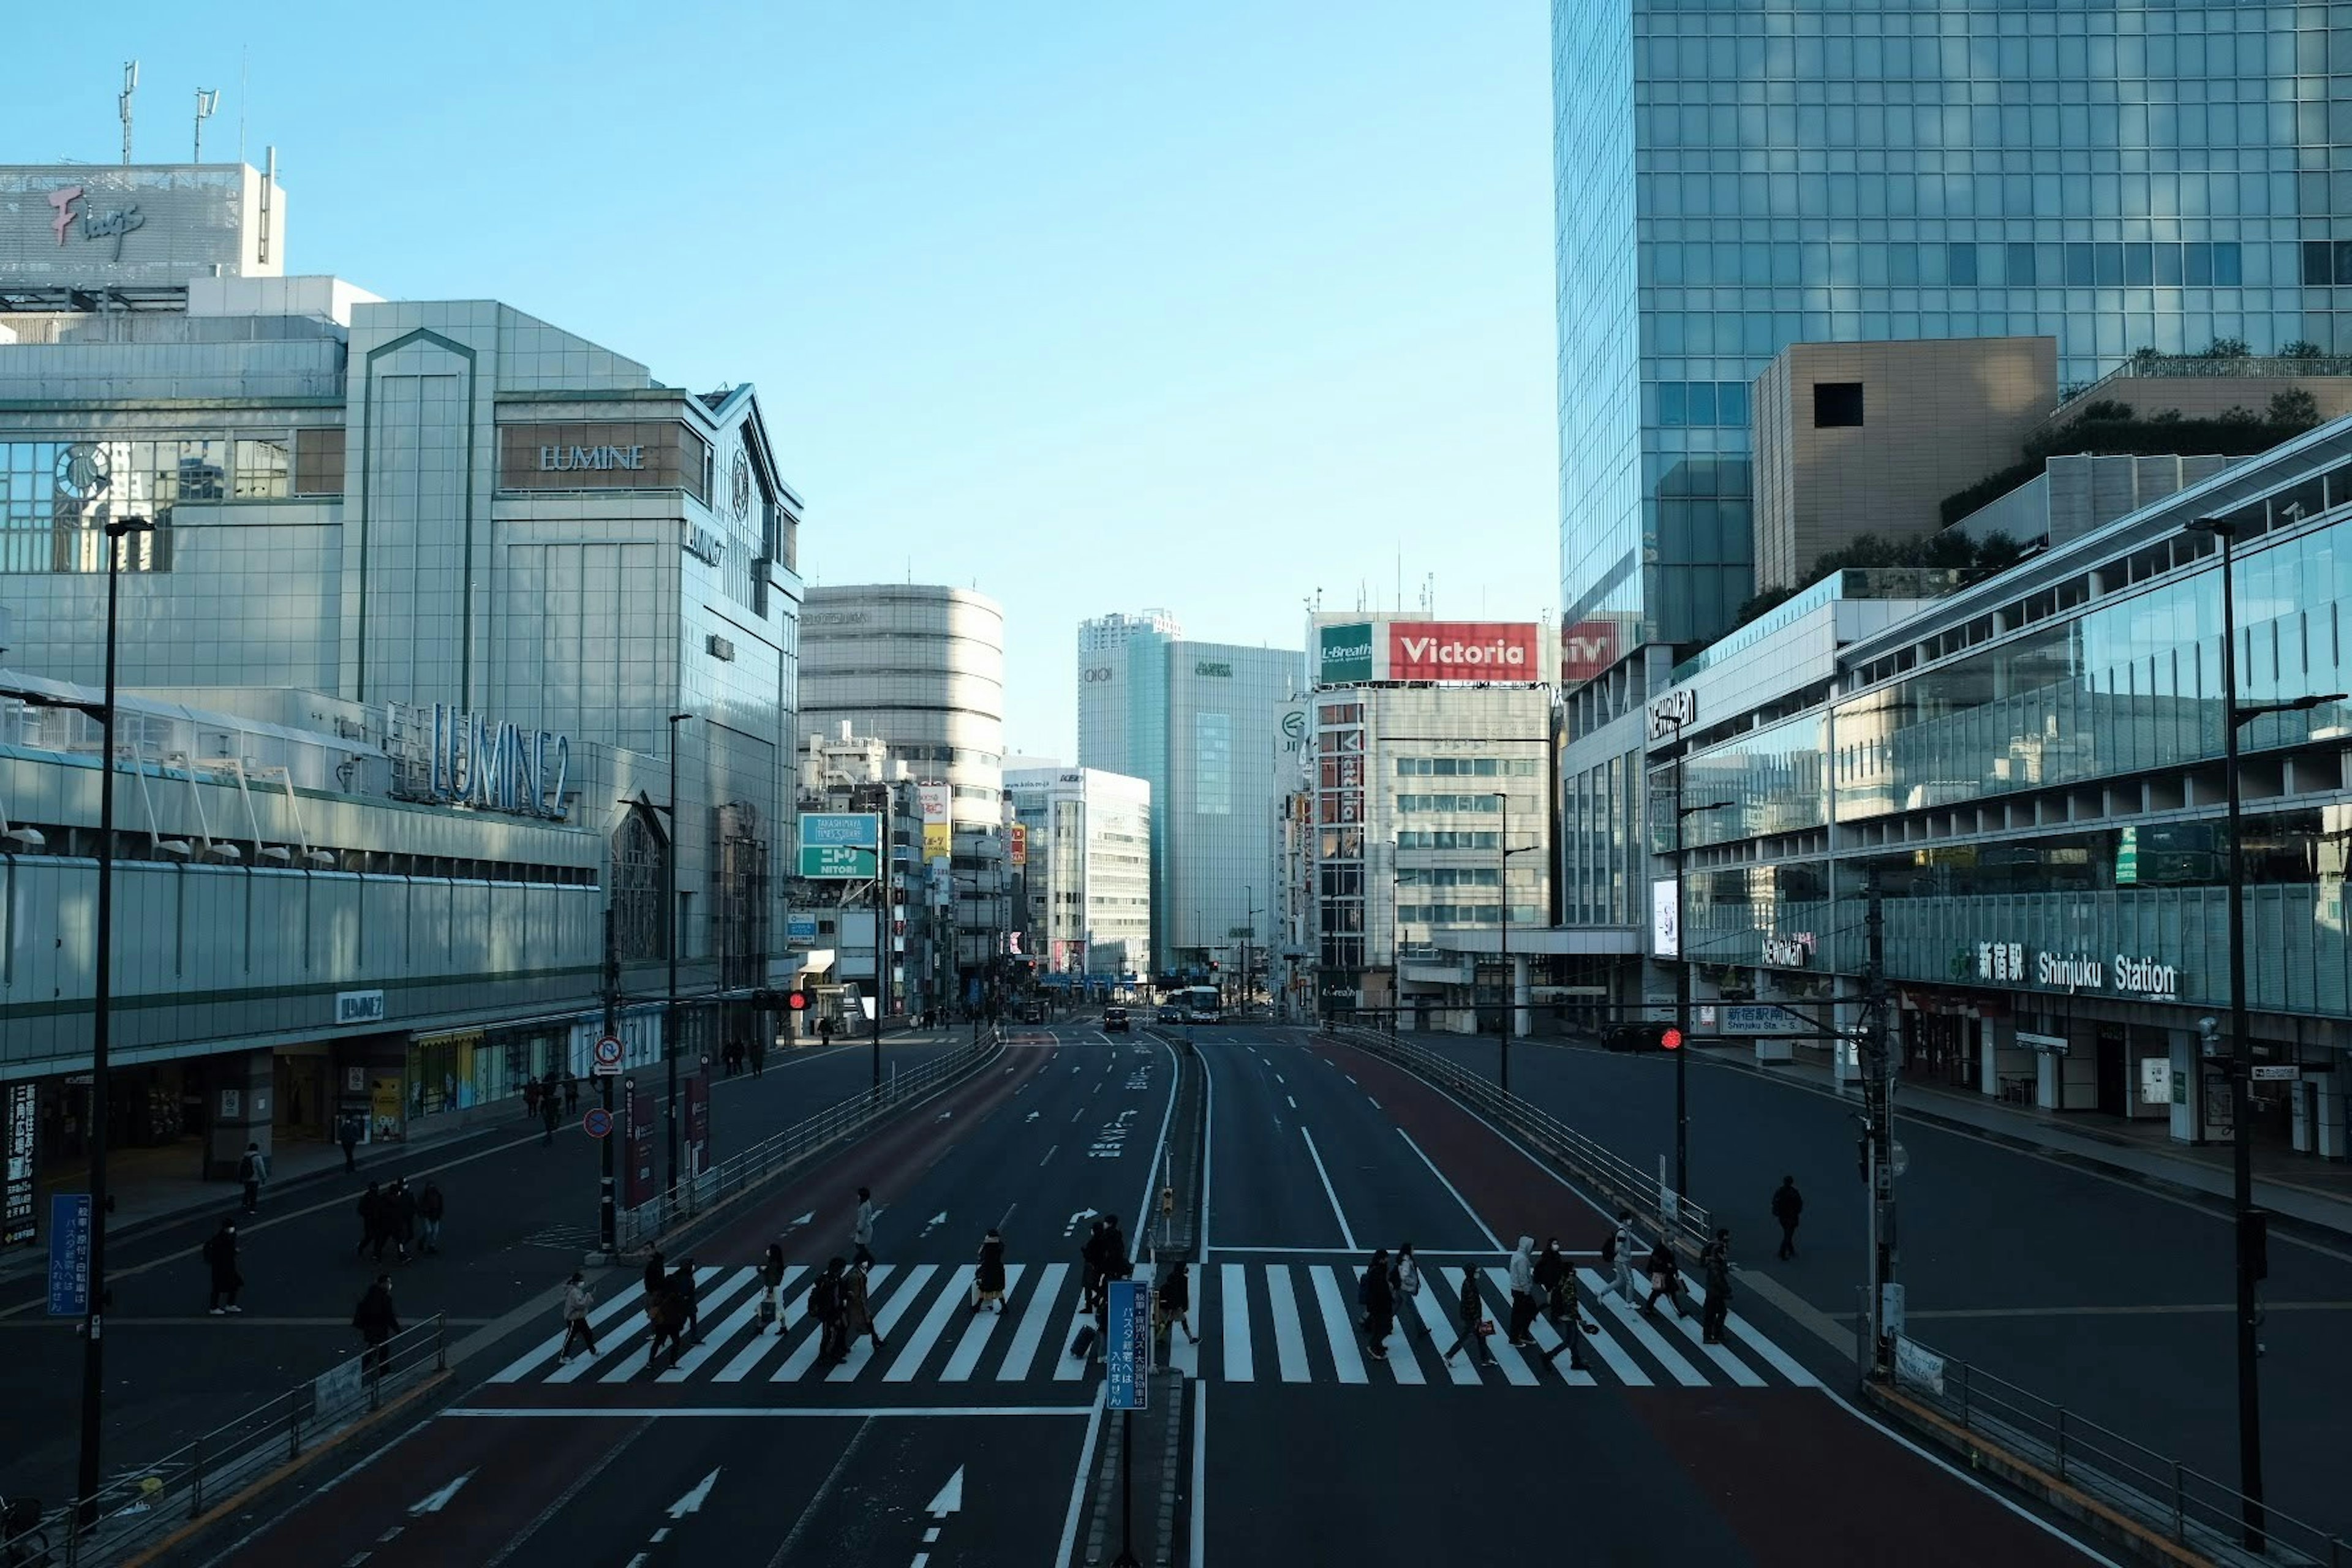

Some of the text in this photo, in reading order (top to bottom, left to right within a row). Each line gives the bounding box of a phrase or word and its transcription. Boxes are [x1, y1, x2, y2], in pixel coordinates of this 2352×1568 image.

[48, 186, 145, 262] Flags
[541, 445, 645, 471] LUMINE
[1322, 643, 1371, 658] L-Breath
[1401, 637, 1524, 665] Victoria
[431, 703, 568, 818] LUMINE 2
[817, 819, 861, 827] TAKASHIMAYA
[821, 849, 857, 863] ニトリ
[821, 865, 856, 875] NITORI
[1979, 941, 2176, 995] 新宿駅 Shinjuku Station
[1728, 1022, 1760, 1030] Shinjuku
[64, 1218, 76, 1291] バスタ新宿へは
[51, 1259, 64, 1313] 入れません
[1122, 1307, 1133, 1384] バスタ新宿へは
[1110, 1351, 1121, 1406] 入れません
